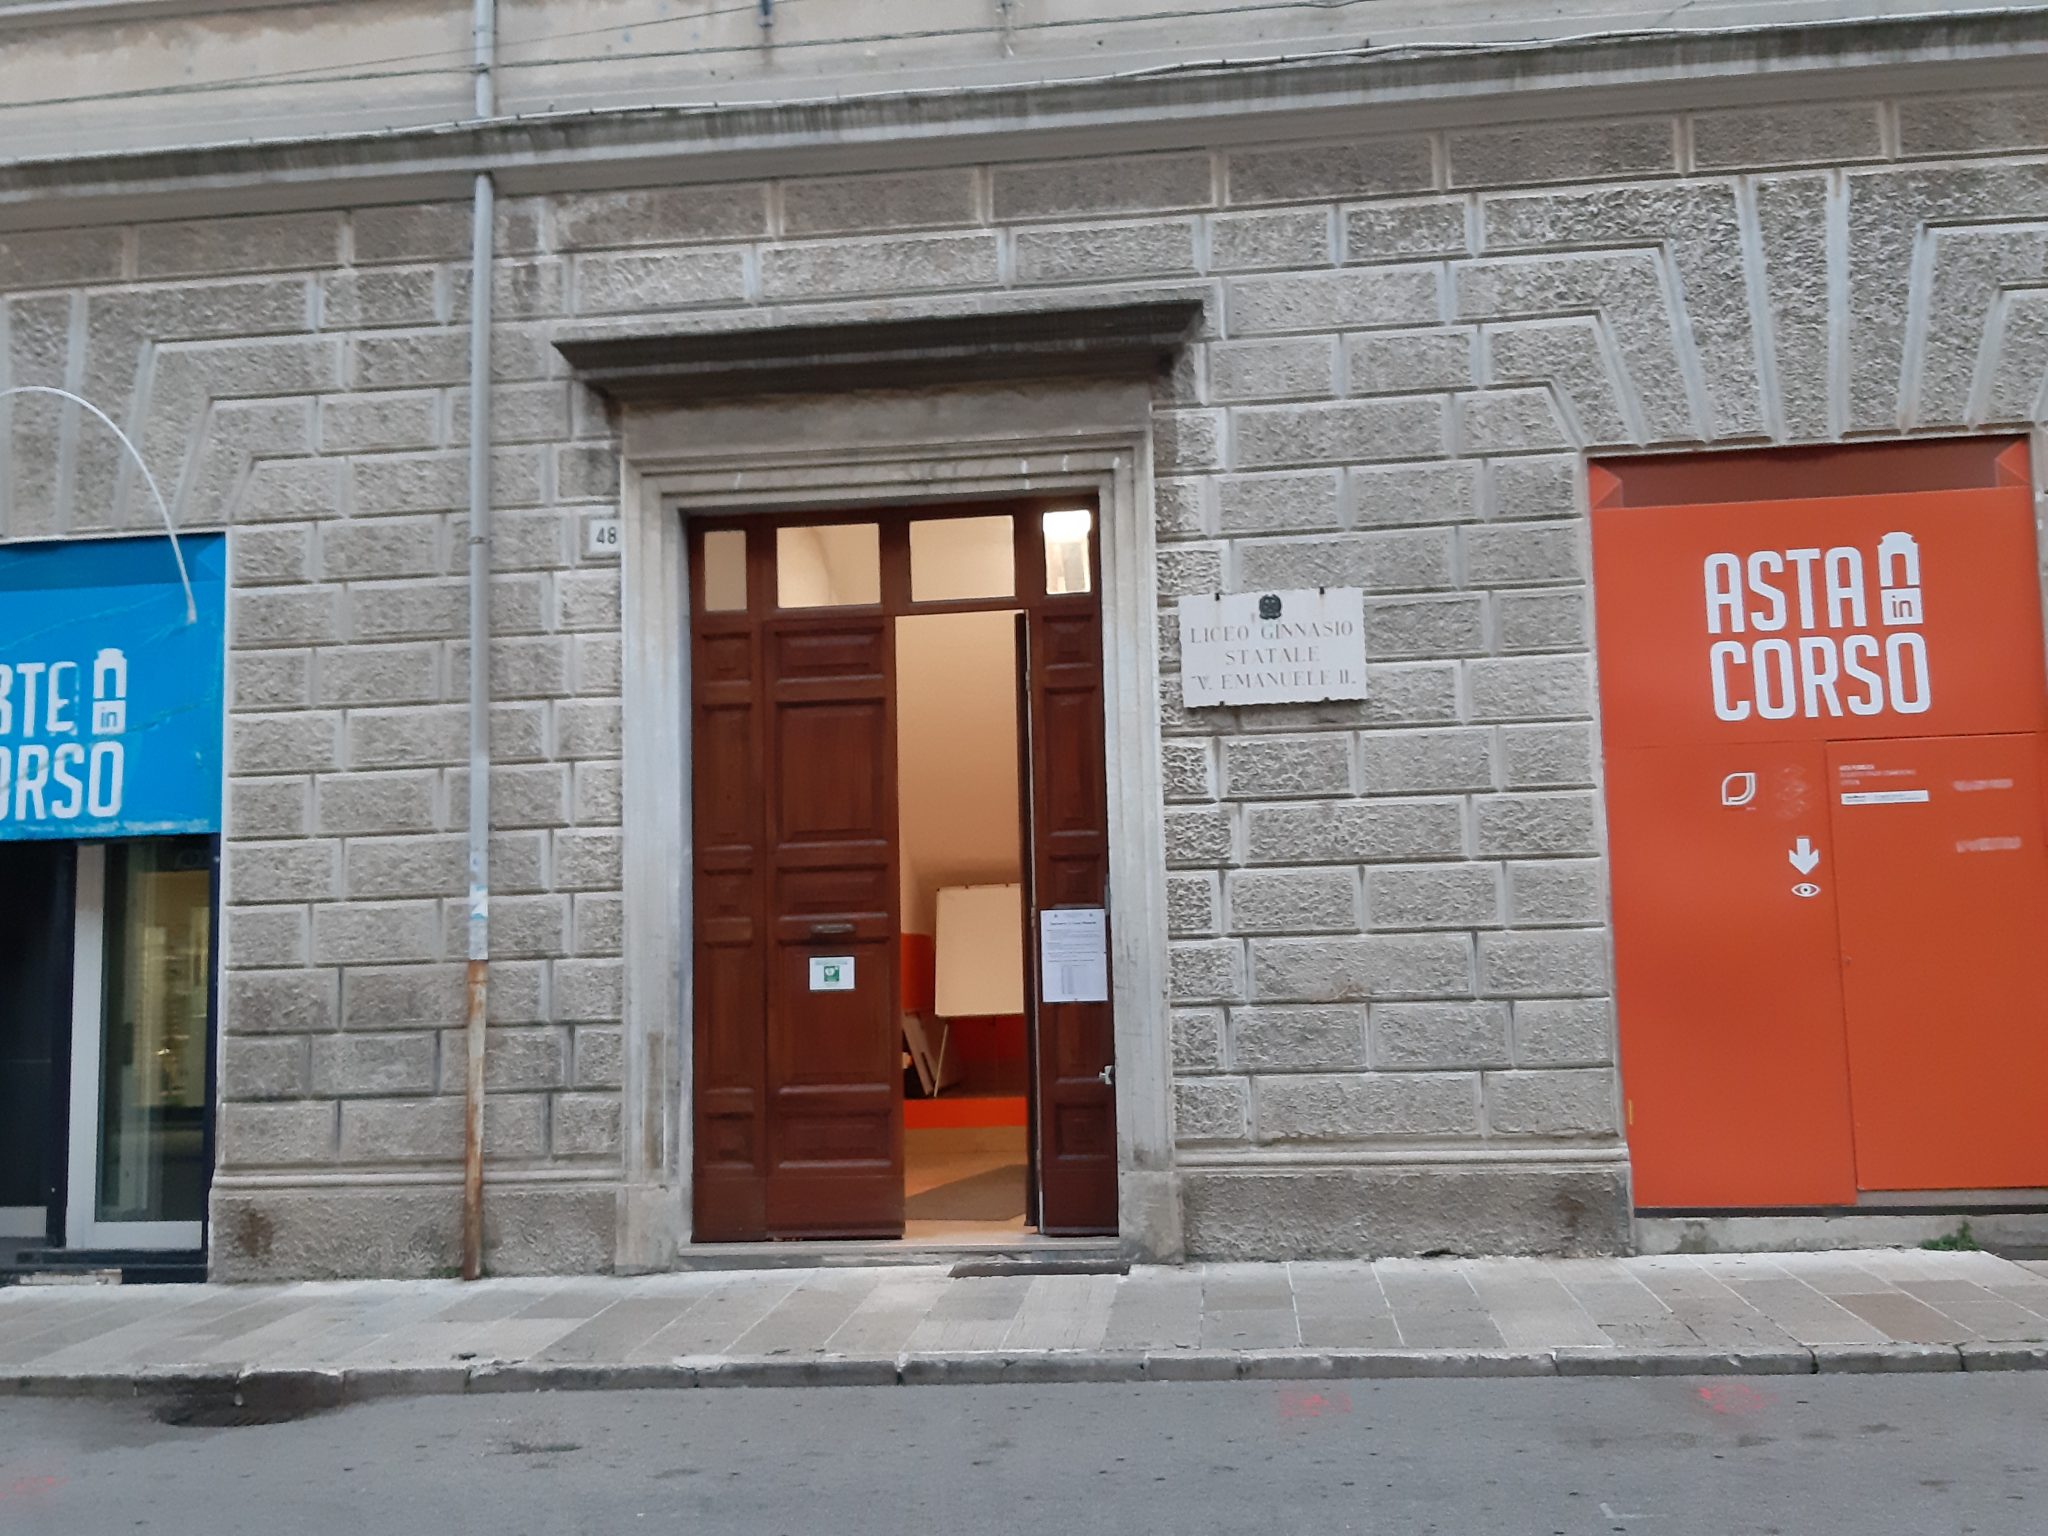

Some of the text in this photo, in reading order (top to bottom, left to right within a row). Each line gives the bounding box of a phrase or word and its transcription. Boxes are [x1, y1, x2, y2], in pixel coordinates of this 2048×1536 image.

[596, 526, 617, 544] 48
[1704, 546, 1913, 633] ASTA in
[1190, 620, 1353, 643] LICEO GINNASIO
[1225, 646, 1319, 665] STATALE
[1221, 669, 1332, 690] EMANUELE
[1710, 632, 1931, 721] CORSO
